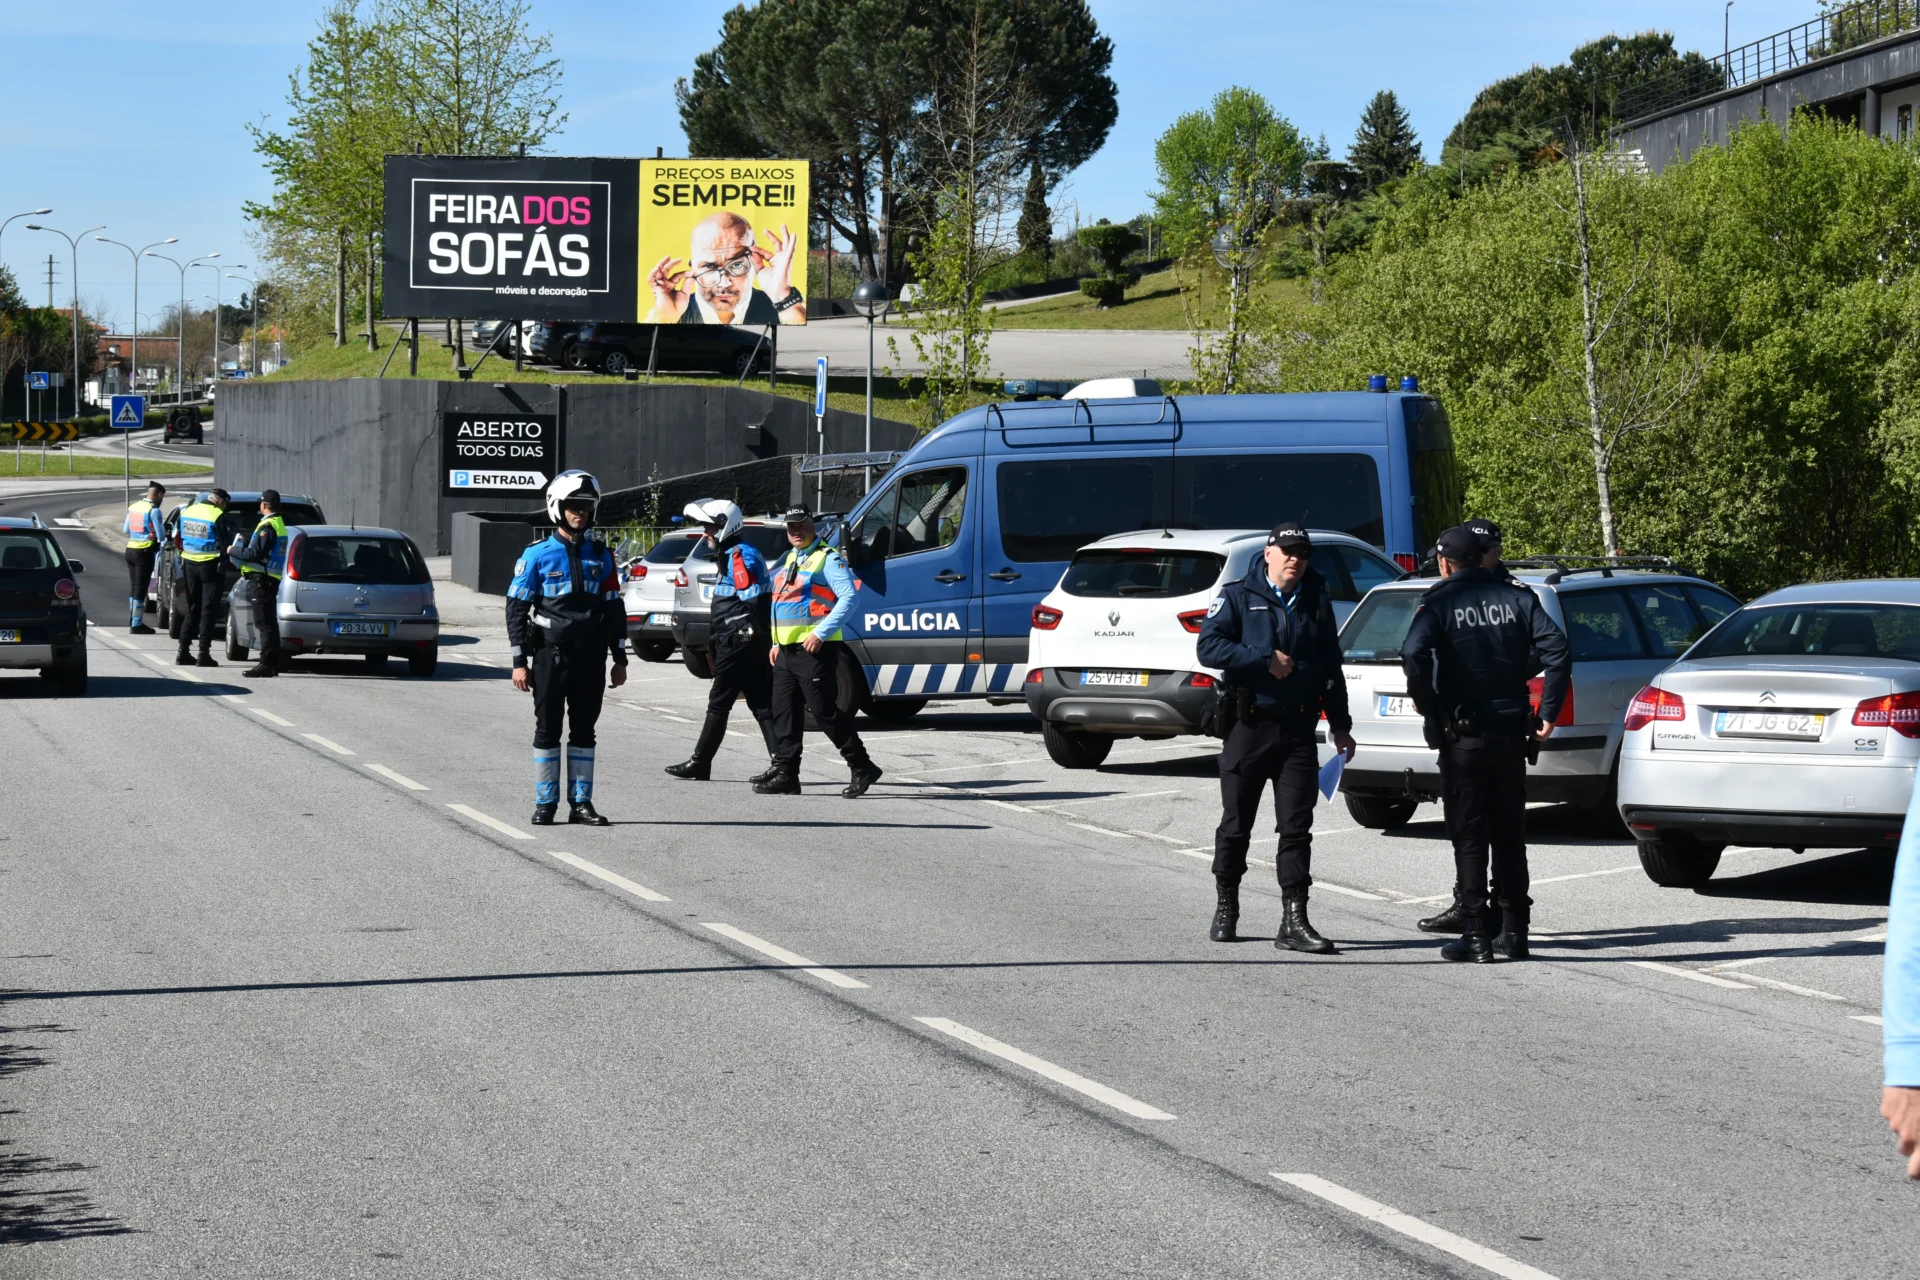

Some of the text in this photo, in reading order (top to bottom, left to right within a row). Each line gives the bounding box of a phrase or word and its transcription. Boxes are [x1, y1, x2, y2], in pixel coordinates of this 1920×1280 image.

[655, 168, 795, 182] PREÇOS BAIXOS
[652, 184, 795, 207] SEMPRE!!
[428, 225, 590, 277] SOFÁS
[495, 286, 528, 295] móveis
[538, 286, 588, 297] decoração
[457, 421, 542, 438] ABERTO
[456, 445, 544, 457] TODOS DIAS
[456, 473, 536, 485] P ENTRADA
[735, 571, 744, 583] T
[864, 609, 961, 632] POLÍCIA
[1454, 601, 1516, 629] POLÍCIA
[1854, 738, 1879, 746] C5
